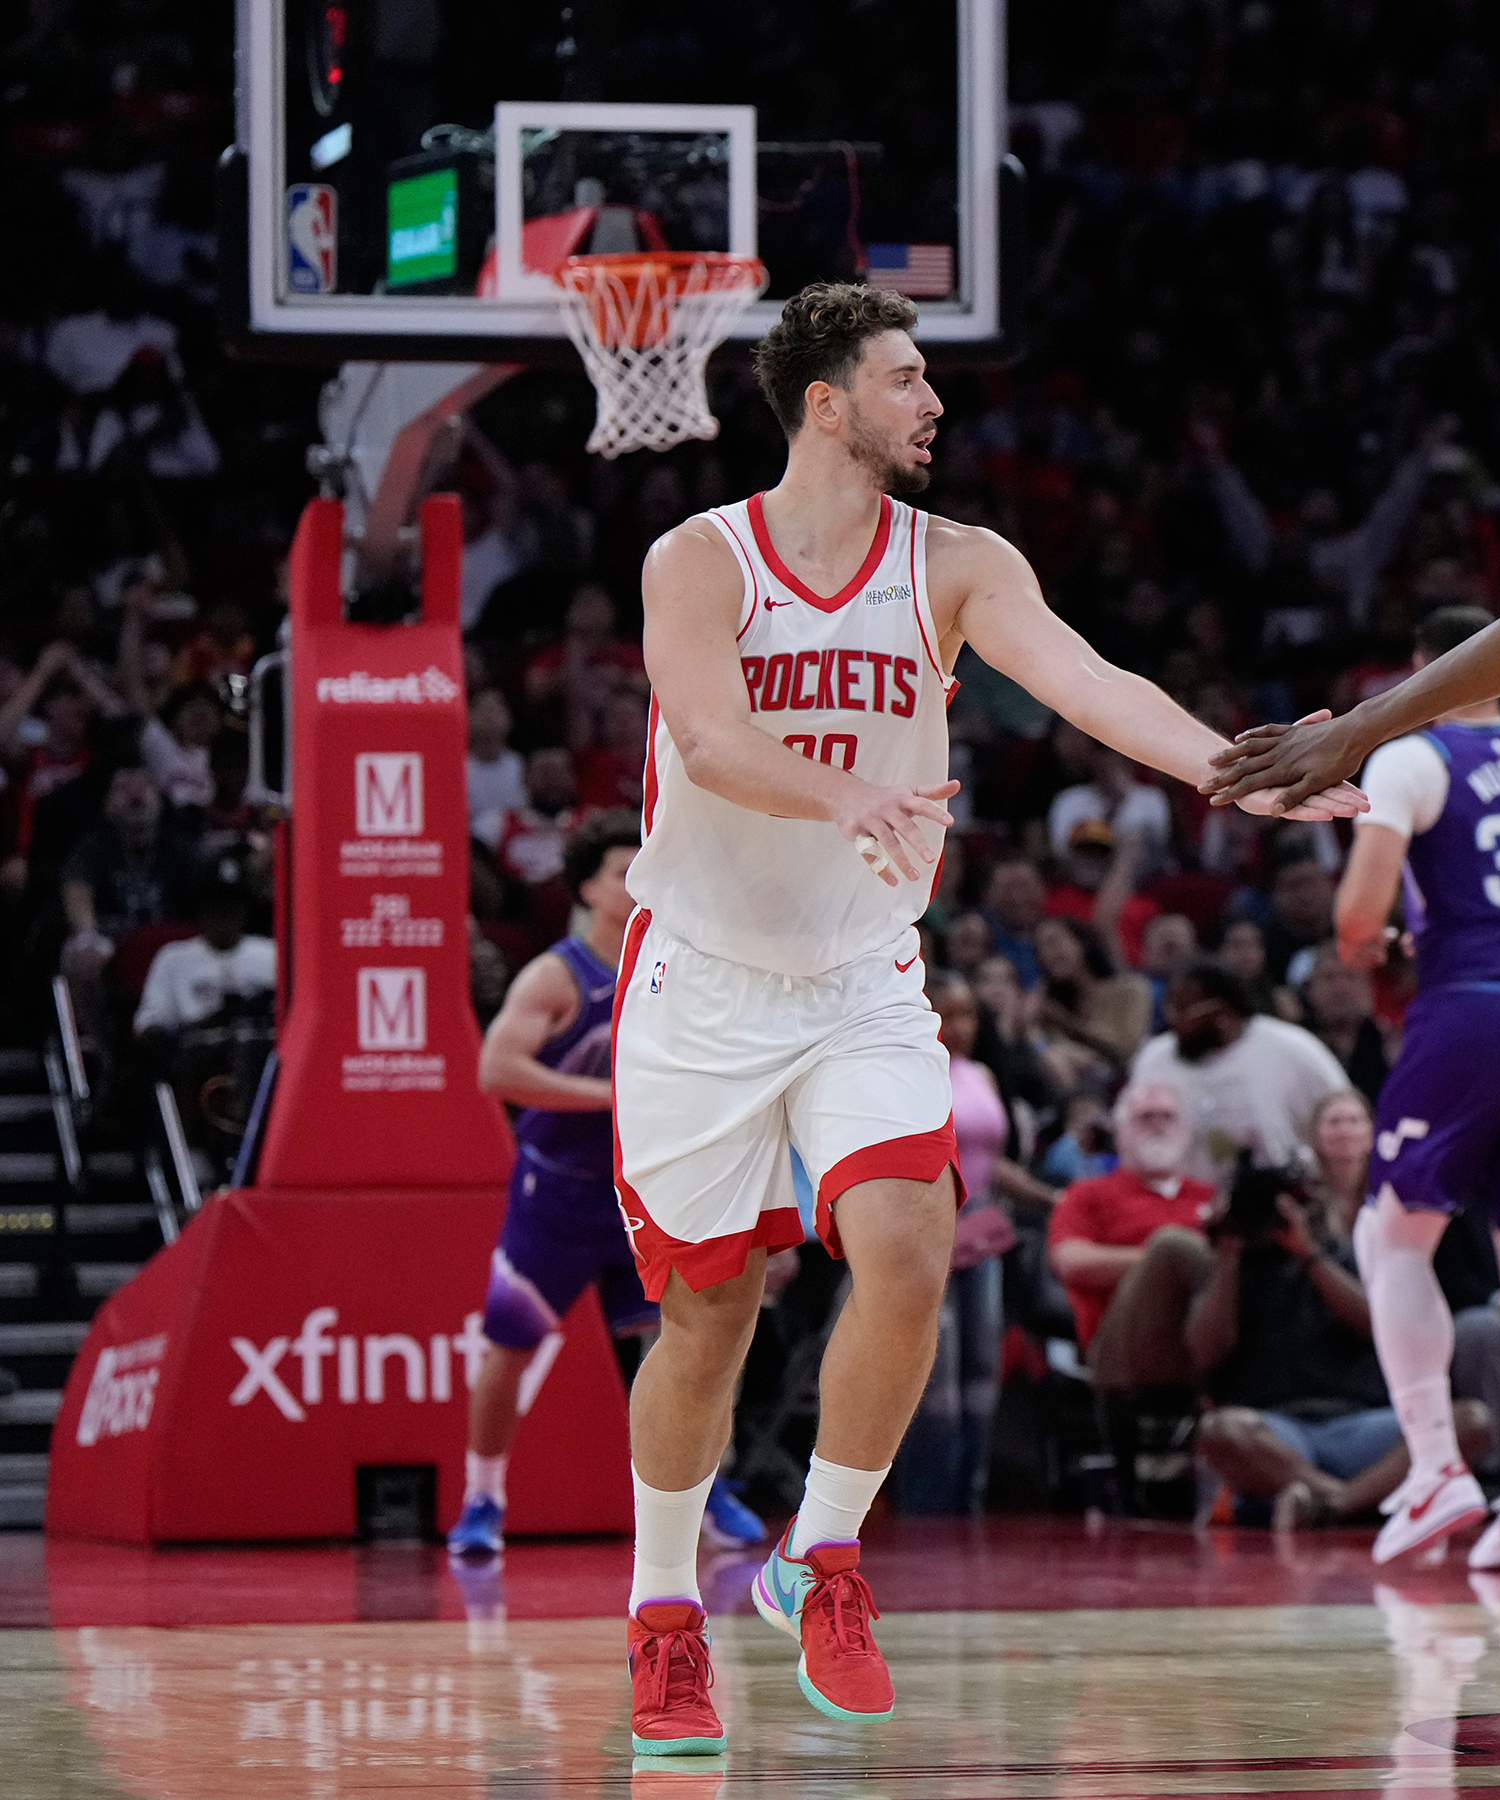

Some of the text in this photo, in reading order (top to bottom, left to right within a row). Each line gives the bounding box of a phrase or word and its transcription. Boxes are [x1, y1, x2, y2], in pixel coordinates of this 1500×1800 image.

[865, 590, 911, 605] HERMANN
[866, 584, 910, 598] MEMORIAL
[317, 671, 424, 704] reliant
[741, 649, 917, 718] ROCKETS
[364, 761, 414, 826] M
[368, 975, 417, 1042] M
